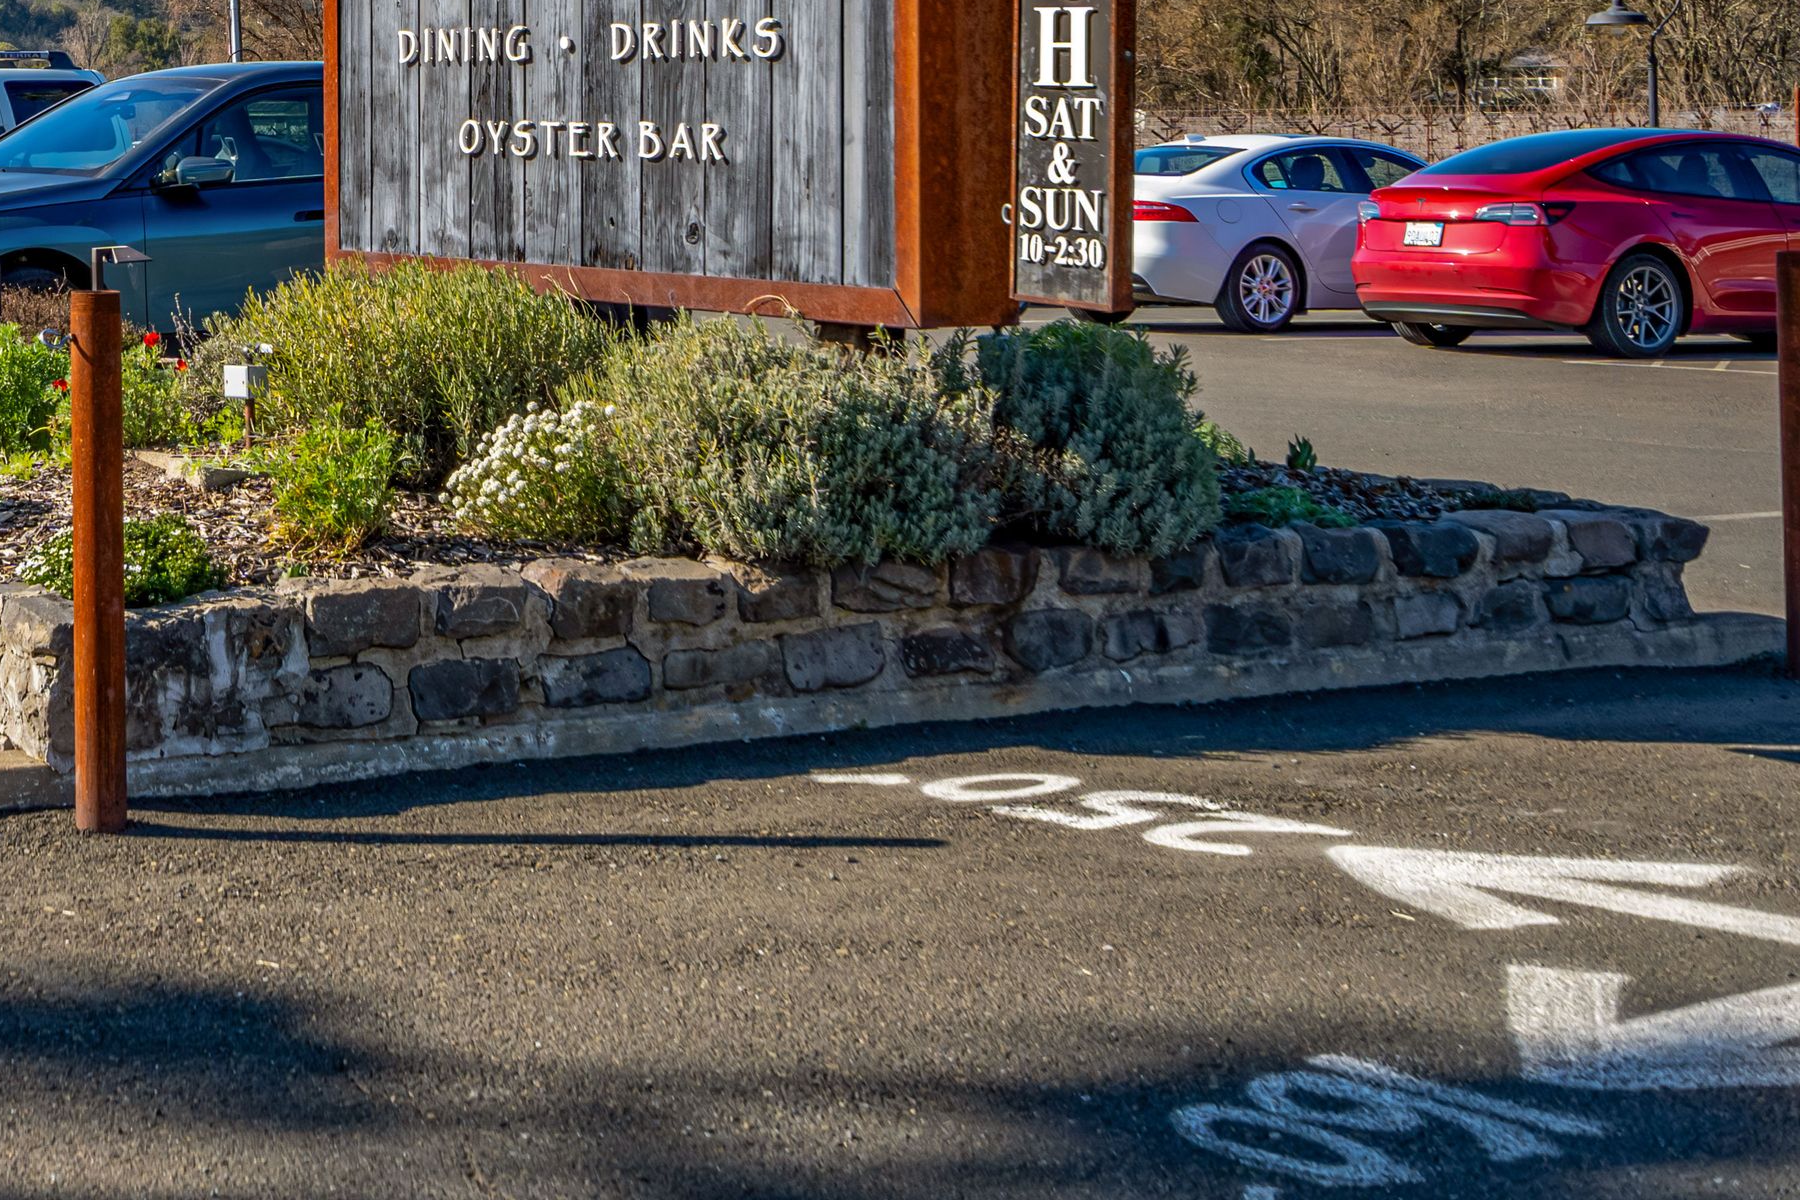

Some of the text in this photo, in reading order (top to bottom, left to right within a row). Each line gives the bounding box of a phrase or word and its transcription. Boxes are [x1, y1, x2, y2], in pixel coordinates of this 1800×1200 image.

[397, 17, 780, 63] DINING DRINKS
[1024, 95, 1100, 140] SAT
[458, 119, 725, 161] OYSTER BAR
[1047, 142, 1076, 185] &
[1019, 186, 1103, 232] SUN
[1019, 233, 1103, 268] 10-2:30
